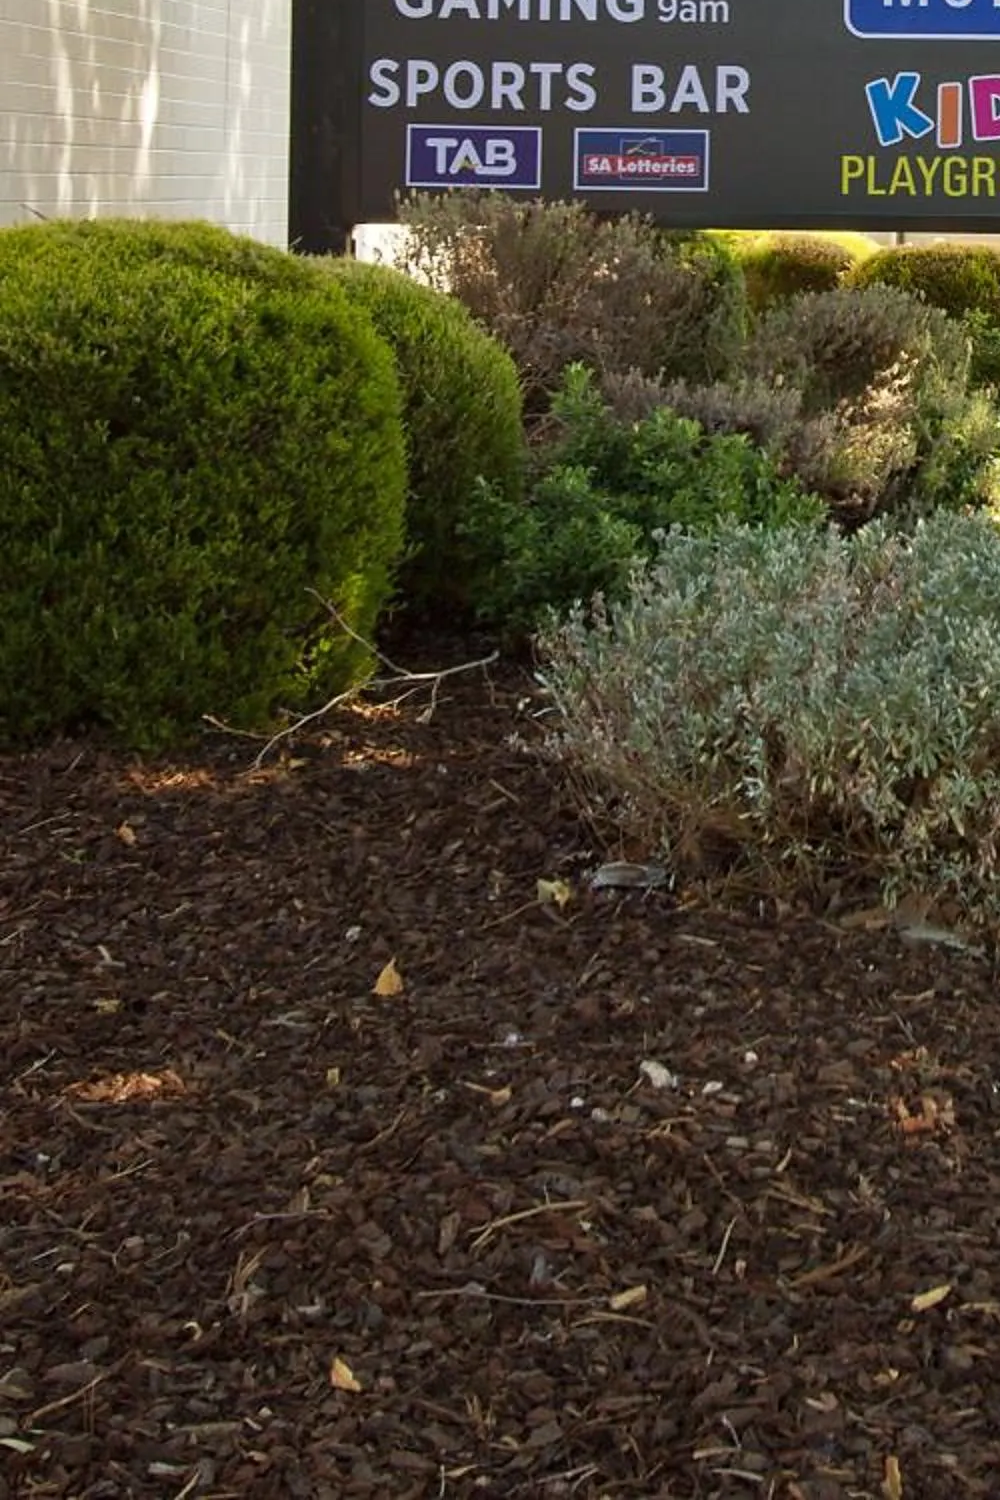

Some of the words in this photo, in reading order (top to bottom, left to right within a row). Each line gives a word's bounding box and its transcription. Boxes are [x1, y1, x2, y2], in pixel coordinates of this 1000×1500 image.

[367, 58, 598, 112] SPORTS
[630, 63, 751, 115] BAR
[425, 136, 518, 176] TAB
[587, 157, 613, 174] SA
[616, 157, 698, 176] Lotteries
